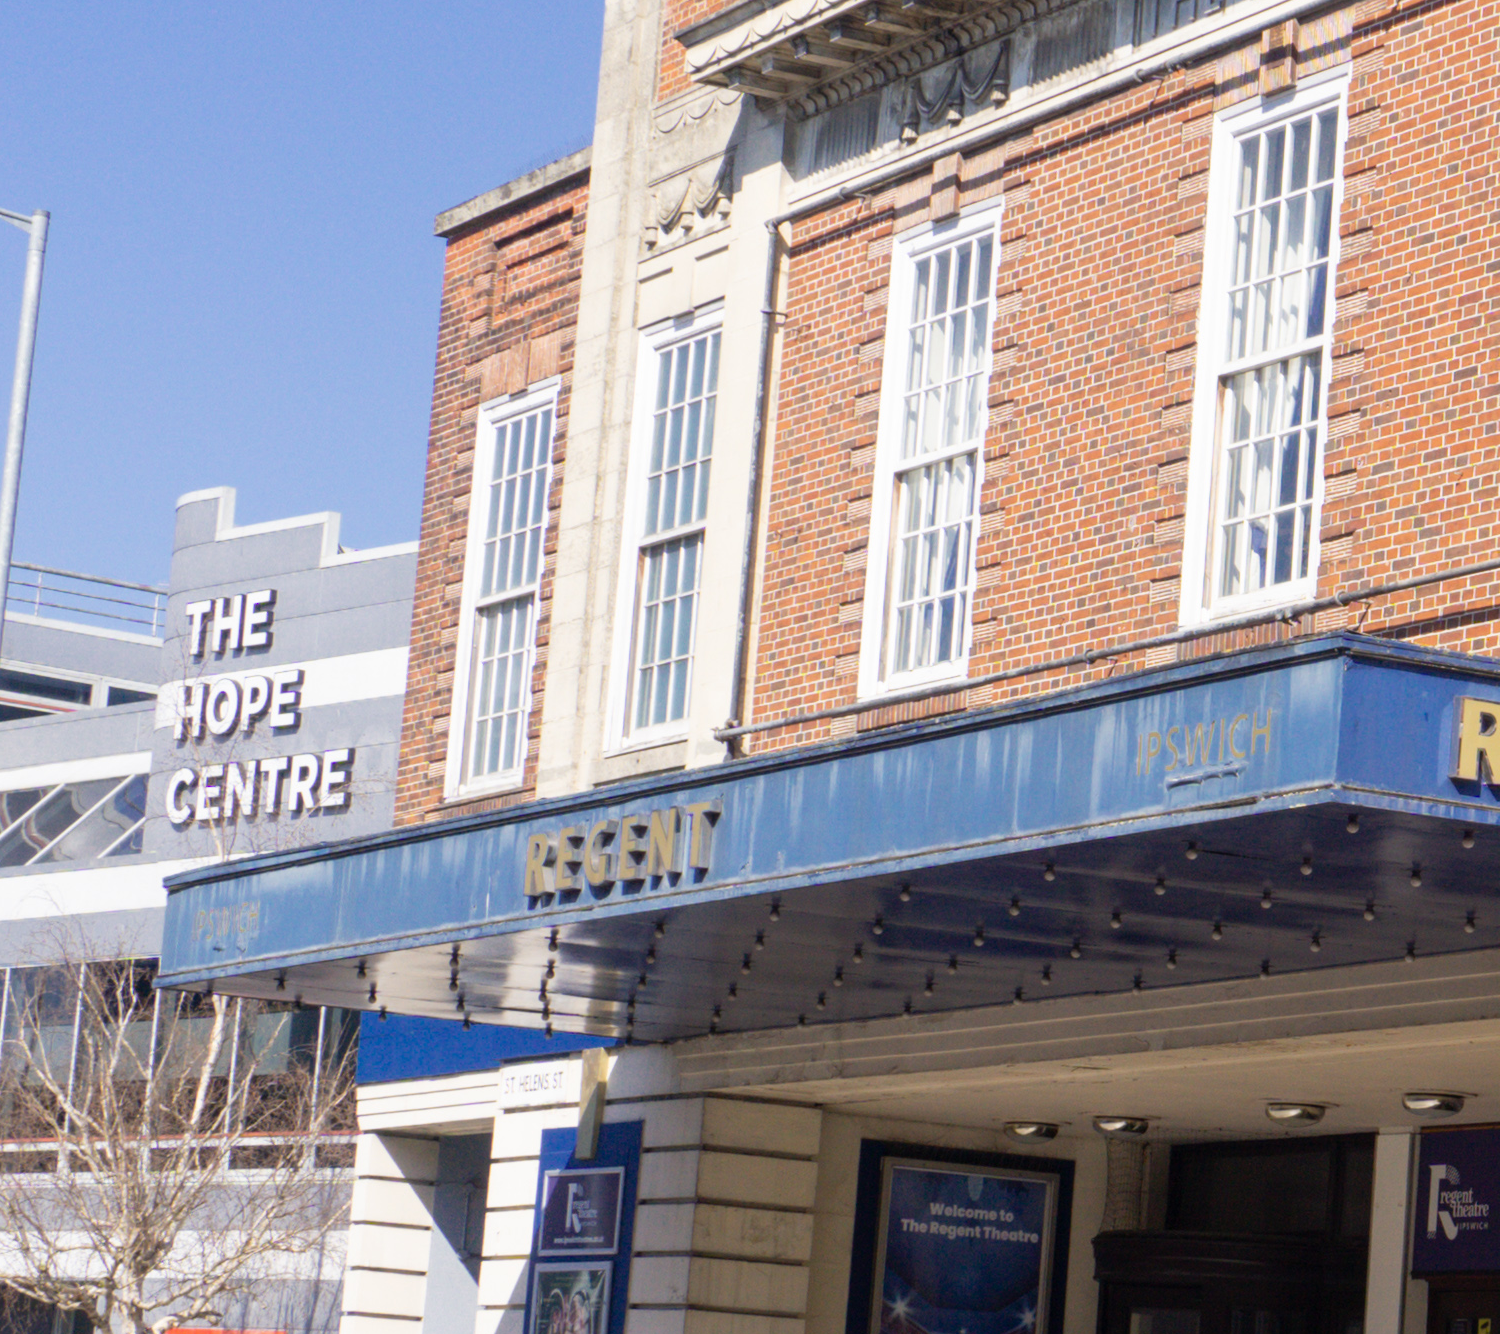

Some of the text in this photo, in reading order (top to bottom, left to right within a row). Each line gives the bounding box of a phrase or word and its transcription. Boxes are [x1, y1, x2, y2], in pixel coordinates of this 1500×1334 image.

[185, 588, 278, 656] THE
[173, 668, 305, 742] HOPE
[1134, 707, 1274, 777] IPSWICH
[165, 747, 356, 826] CENTRE
[524, 797, 722, 905] REGENT
[191, 899, 261, 942] IPSWICH
[929, 1202, 1015, 1223] Welcome to
[1439, 1187, 1474, 1206] regent
[1450, 1202, 1490, 1218] theatre
[900, 1218, 1040, 1244] The Regent Theatre
[1458, 1221, 1489, 1231] IPSWICH
